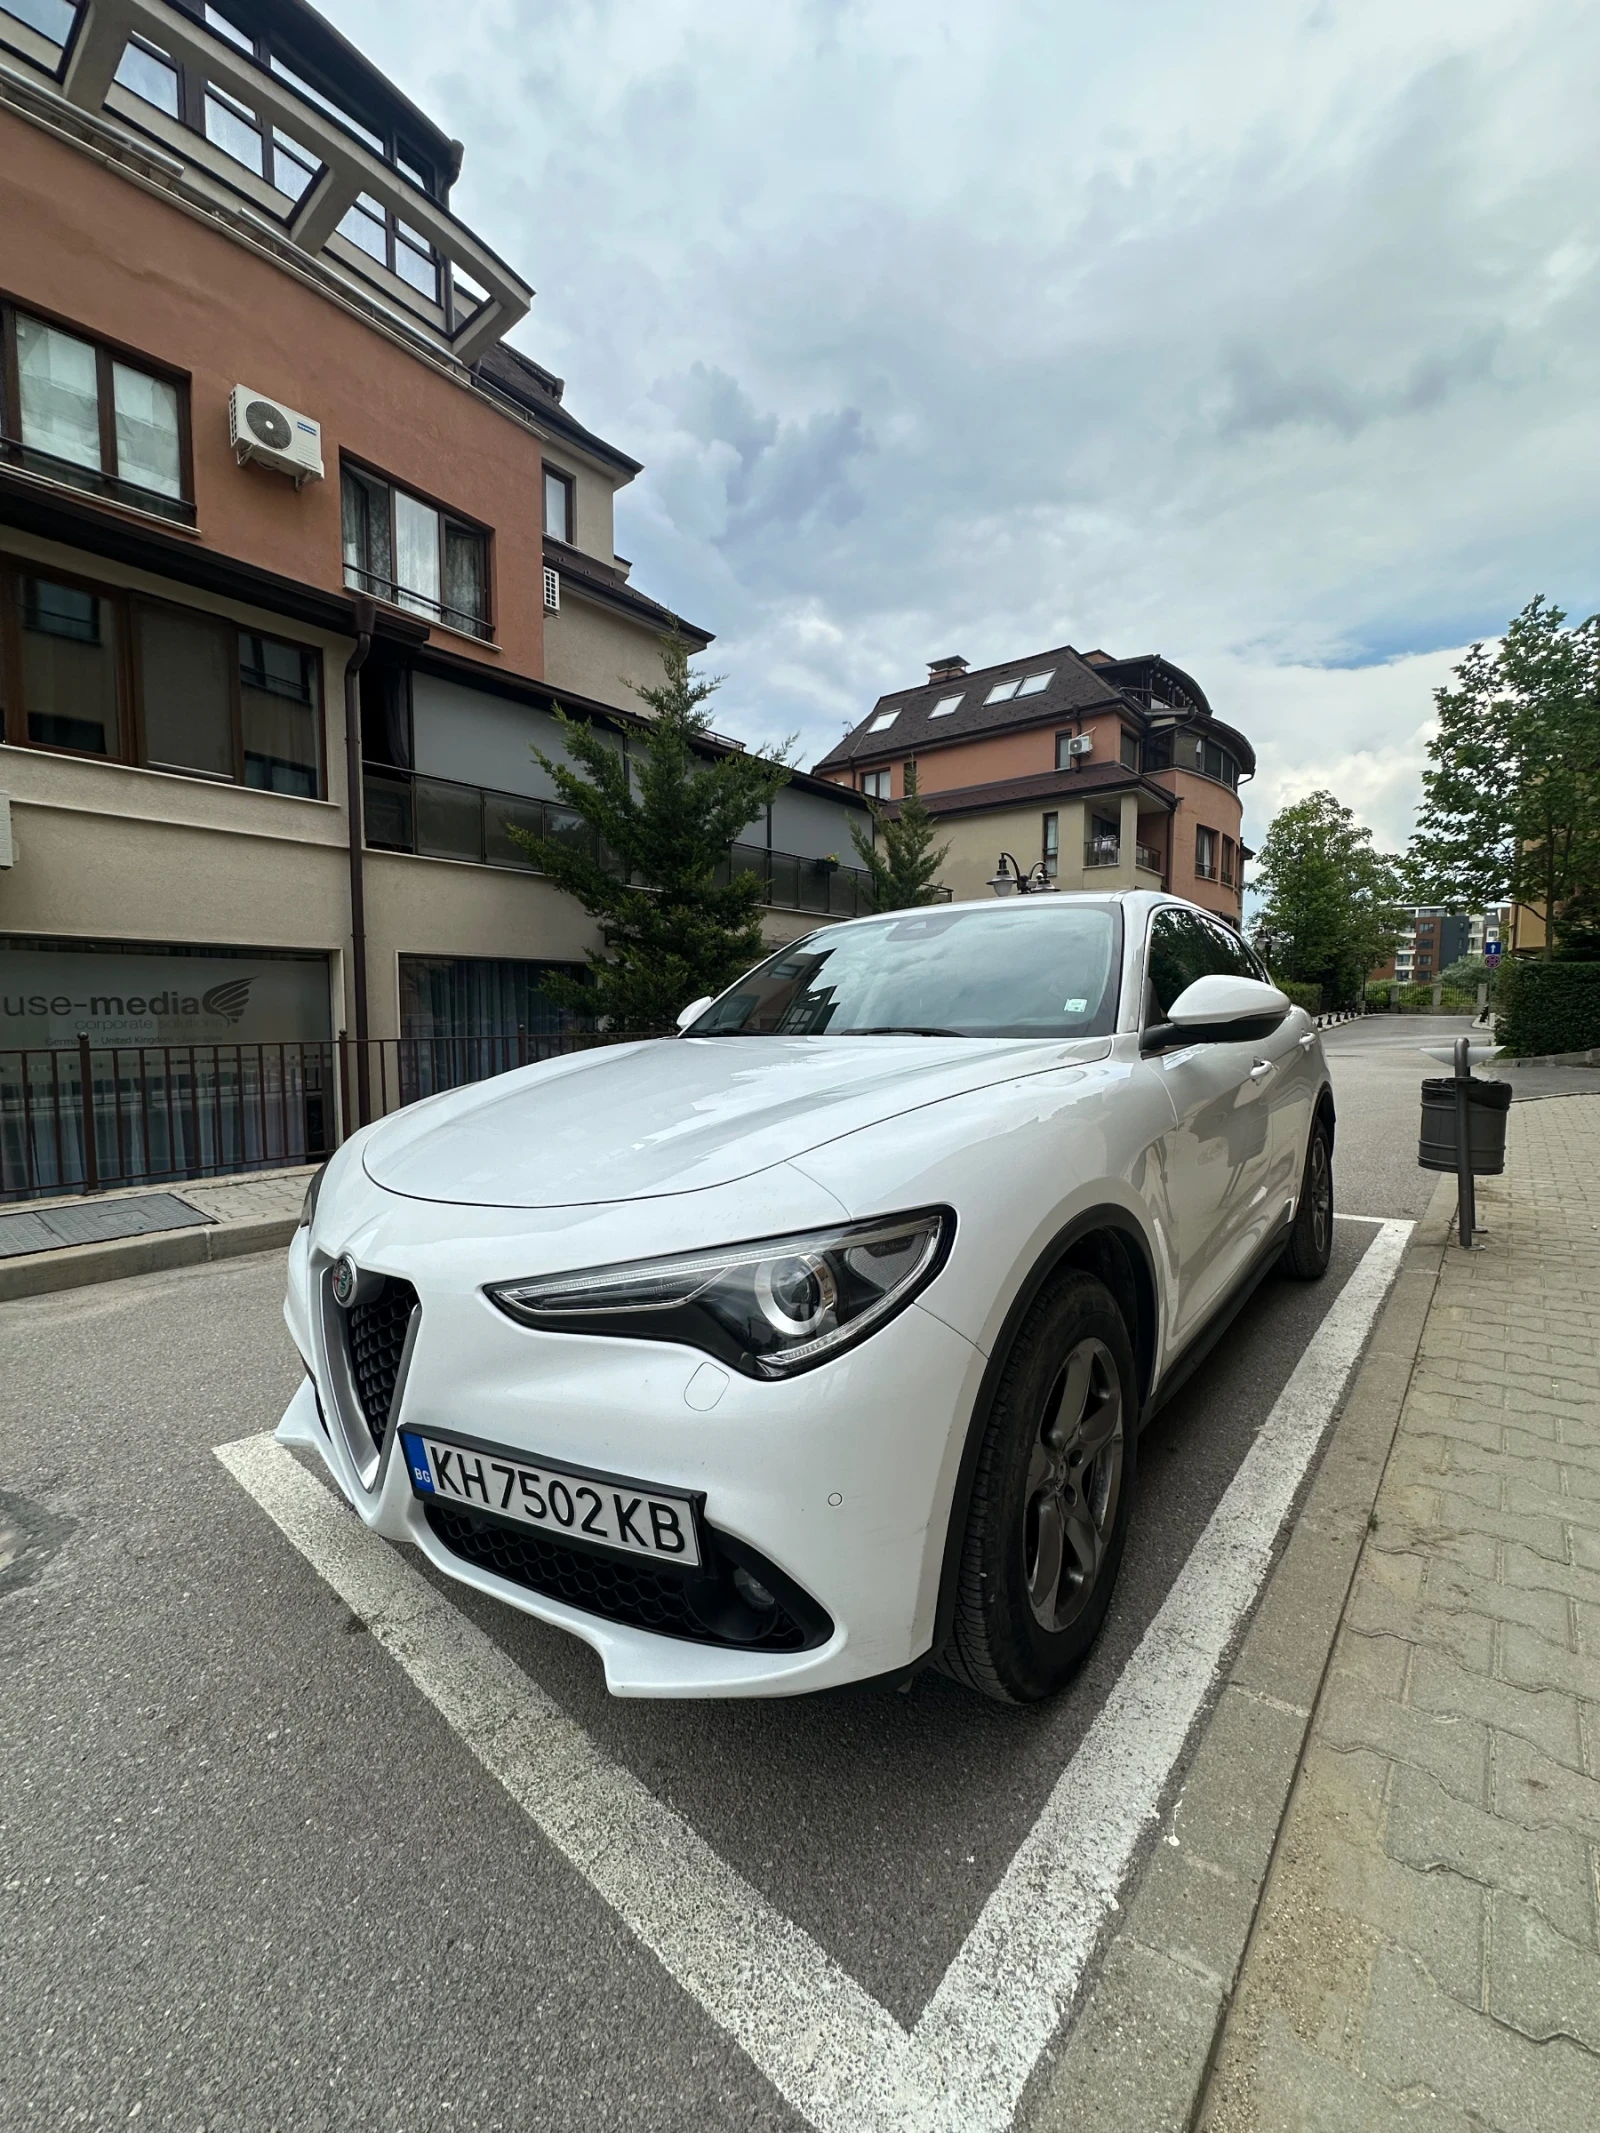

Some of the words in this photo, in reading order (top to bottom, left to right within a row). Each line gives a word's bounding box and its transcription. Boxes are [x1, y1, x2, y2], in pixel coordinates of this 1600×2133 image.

[74, 1018, 154, 1032] corporate
[45, 1037, 80, 1047] Germa
[101, 1036, 133, 1046] United
[134, 1035, 173, 1046] Kingdom
[414, 1467, 432, 1484] BG
[428, 1446, 686, 1554] KH7502KB
